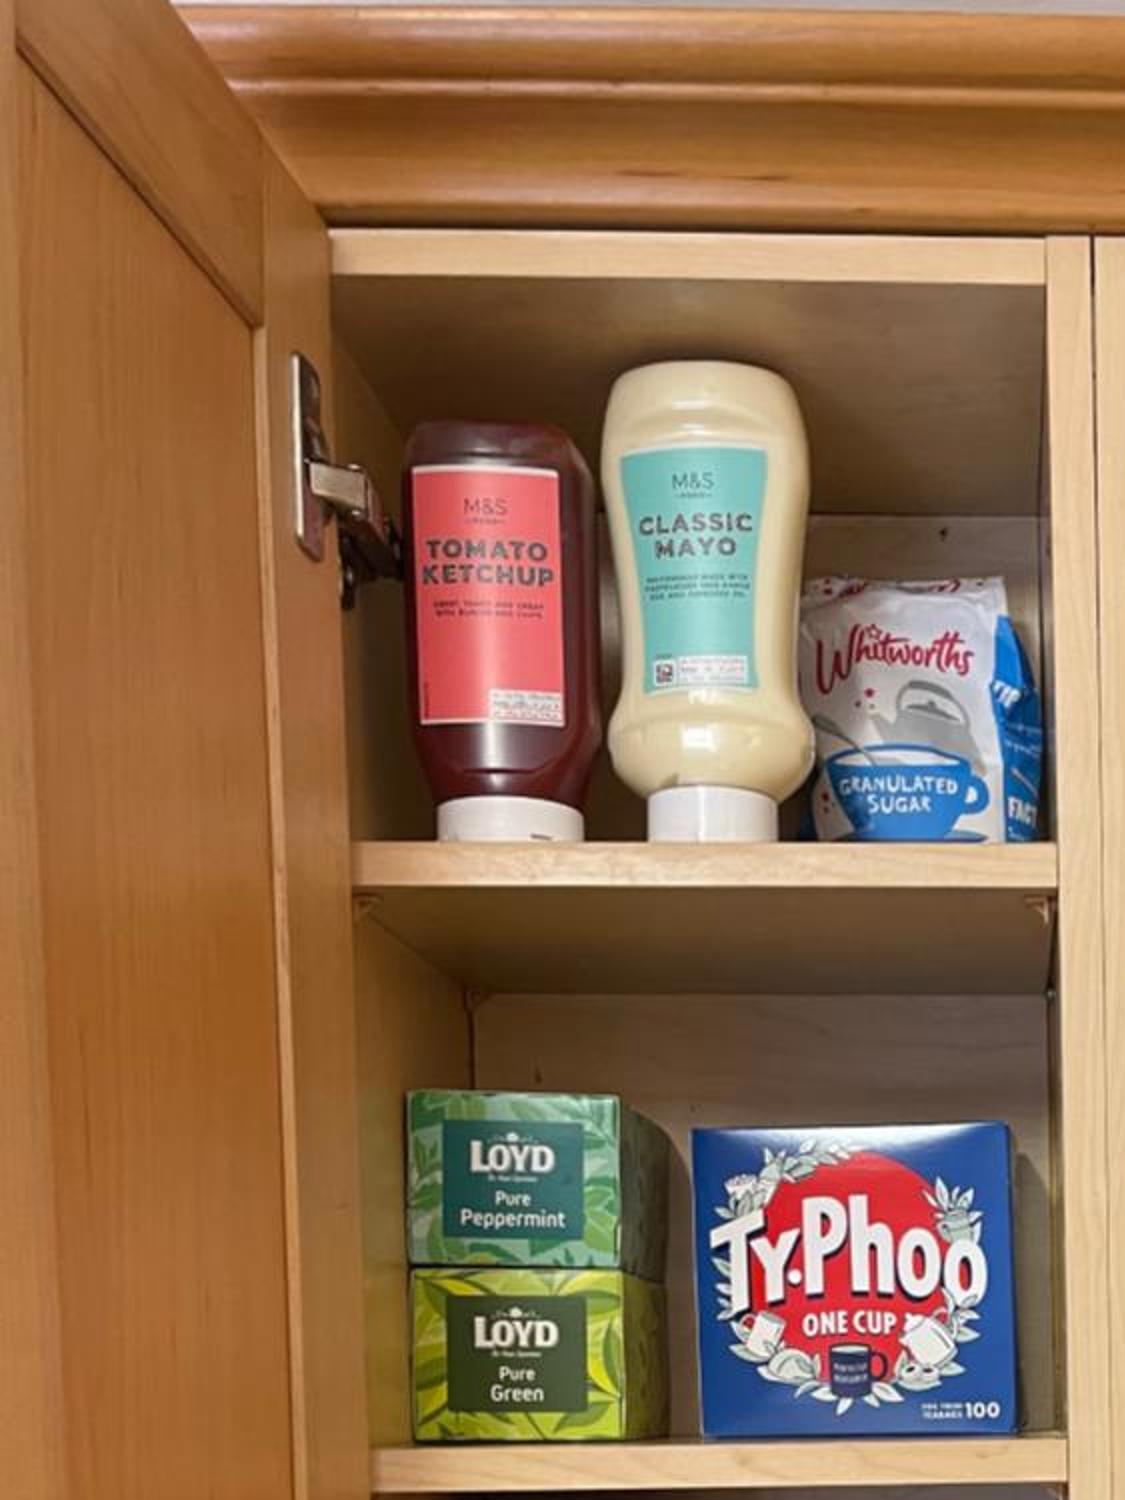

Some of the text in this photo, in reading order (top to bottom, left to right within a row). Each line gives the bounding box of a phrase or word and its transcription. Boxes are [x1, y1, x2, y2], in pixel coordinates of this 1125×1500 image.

[672, 471, 715, 490] M&S
[464, 498, 508, 516] M&S
[639, 512, 753, 535] CLASSIC
[426, 539, 548, 562] TOMATO
[655, 537, 737, 559] MAYO
[422, 564, 555, 586] KETCHUP
[816, 624, 975, 695] Whitworths
[839, 775, 958, 795] GRANULATED
[867, 796, 933, 814] SUGAR
[469, 1140, 556, 1173] LOYD
[495, 1190, 532, 1207] Pure
[460, 1208, 567, 1230] Peppermint
[474, 1316, 559, 1348] LOYD
[803, 1311, 897, 1337] ONE CUP
[499, 1366, 536, 1381] Pure
[490, 1384, 545, 1402] Green
[965, 1401, 1000, 1419] 100
